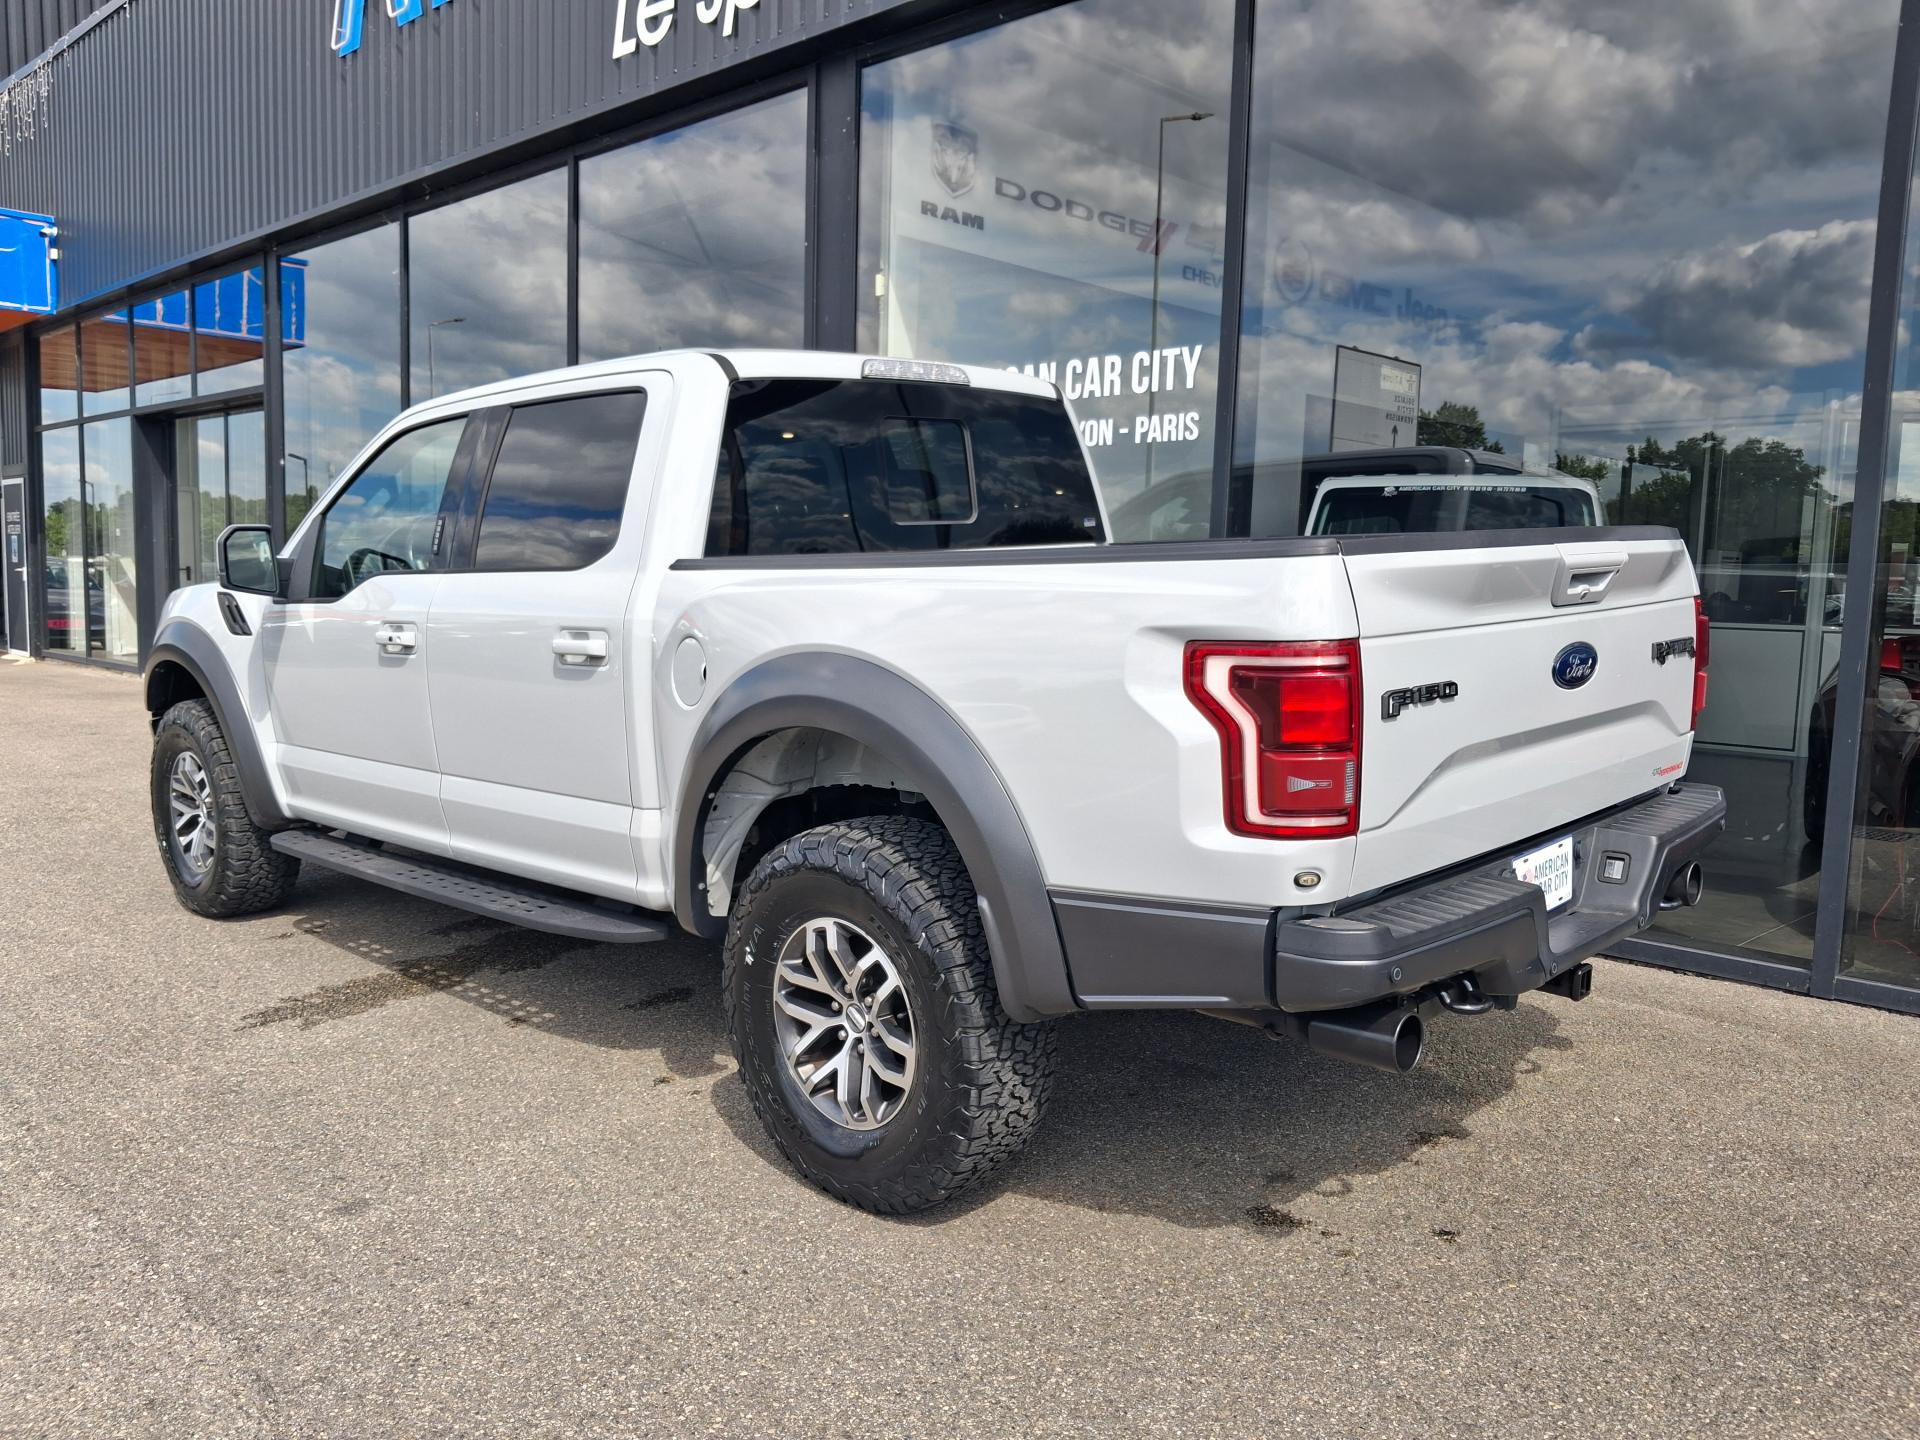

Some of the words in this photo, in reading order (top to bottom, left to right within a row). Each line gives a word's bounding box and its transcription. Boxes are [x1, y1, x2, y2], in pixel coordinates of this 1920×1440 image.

[612, 0, 675, 59] Le
[920, 199, 985, 232] RAM
[994, 176, 1153, 239] DODGE
[1065, 354, 1122, 401] CAR
[1131, 344, 1203, 395] CITY
[1135, 411, 1200, 444] PARIS
[1534, 850, 1569, 881] AMERICAN
[1554, 869, 1569, 892] CITY
